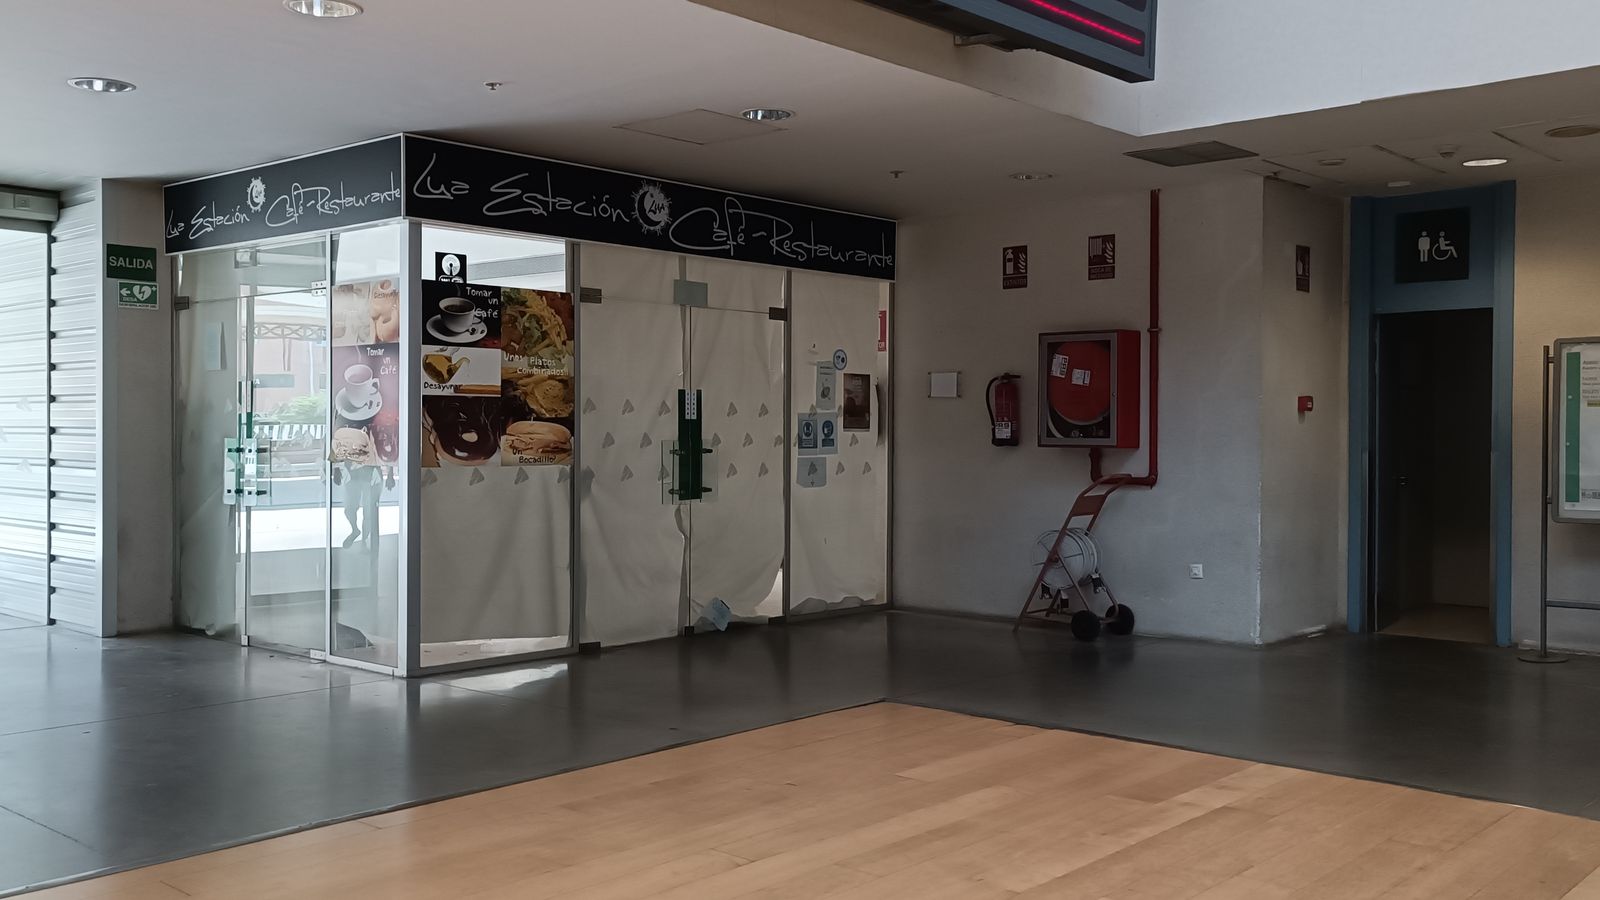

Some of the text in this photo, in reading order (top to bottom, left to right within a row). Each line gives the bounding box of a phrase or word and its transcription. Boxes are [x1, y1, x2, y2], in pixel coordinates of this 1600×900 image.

[482, 171, 630, 223] Estación
[109, 255, 154, 270] SALIDA
[465, 286, 493, 297] Tomar
[366, 347, 385, 357] Tomar
[423, 381, 463, 393] Desayunar
[512, 448, 523, 456] Un
